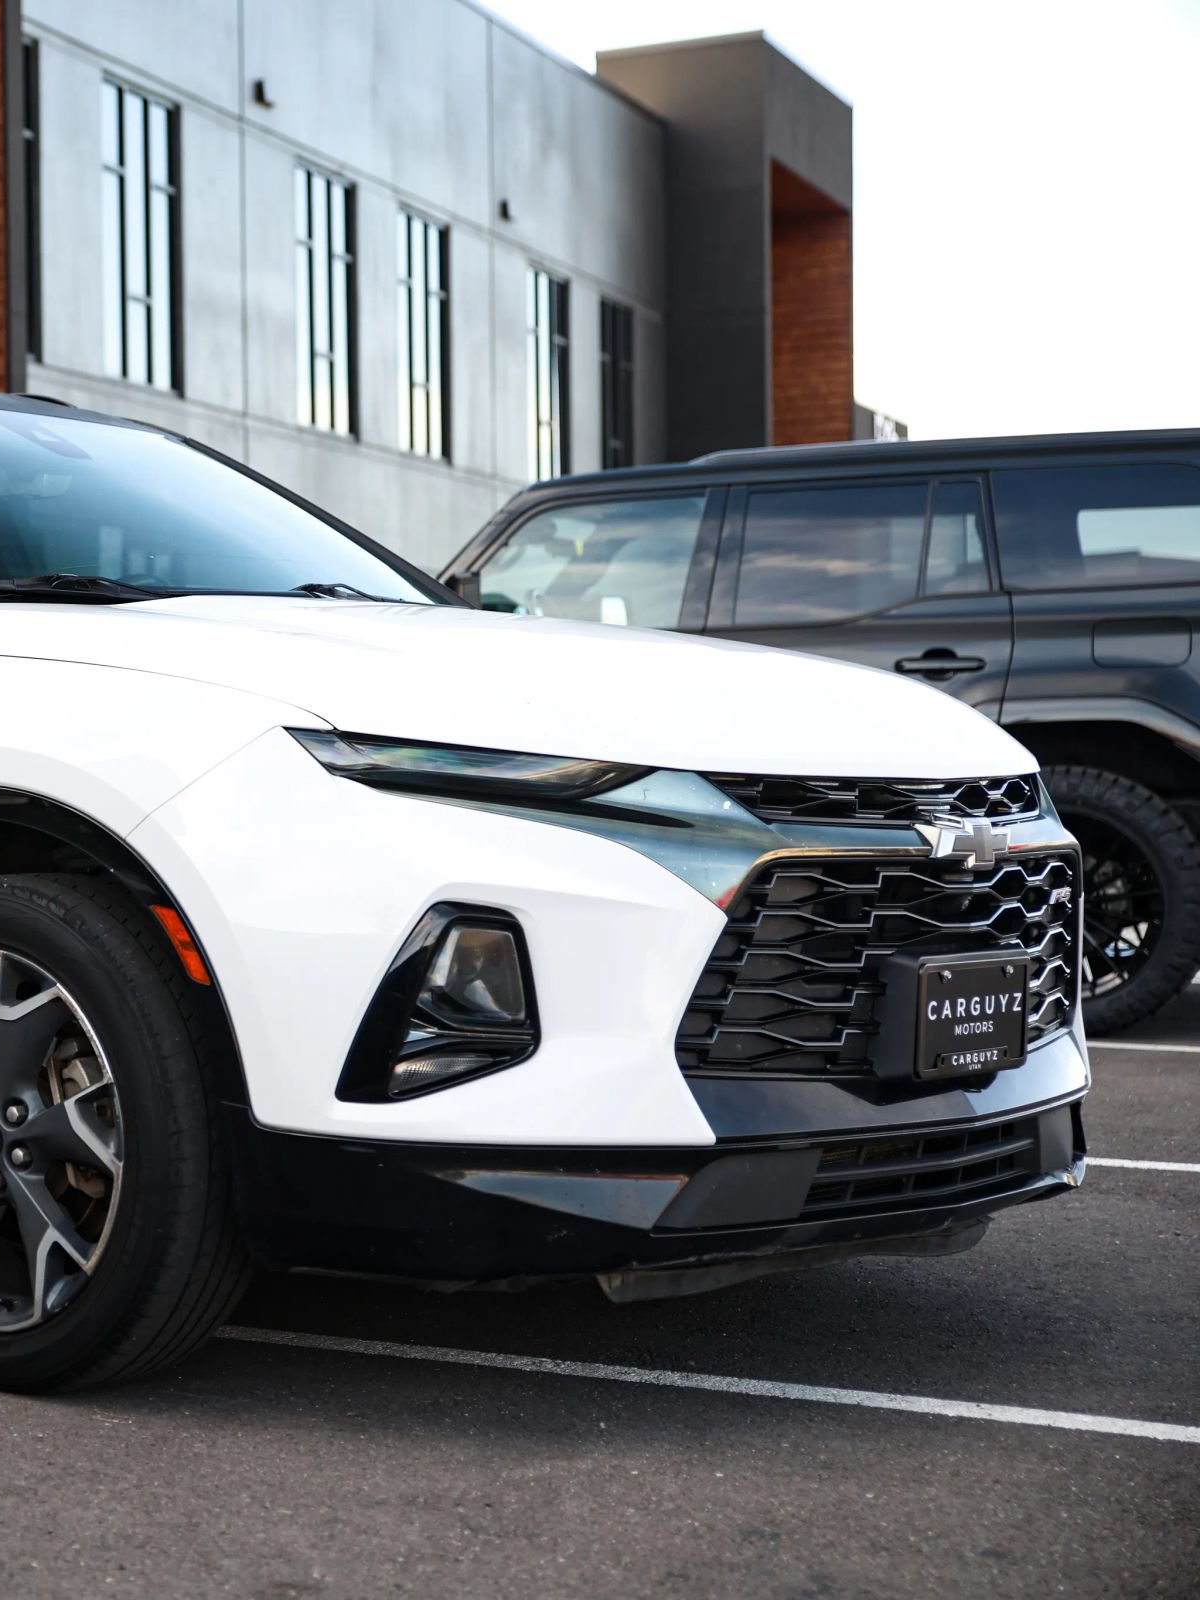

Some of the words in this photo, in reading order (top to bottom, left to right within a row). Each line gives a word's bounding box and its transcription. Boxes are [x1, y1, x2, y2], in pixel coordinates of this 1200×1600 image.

[927, 993, 1022, 1020] CARGUYZ
[955, 1021, 994, 1036] MOTORS
[952, 1050, 998, 1066] CARGUYZ
